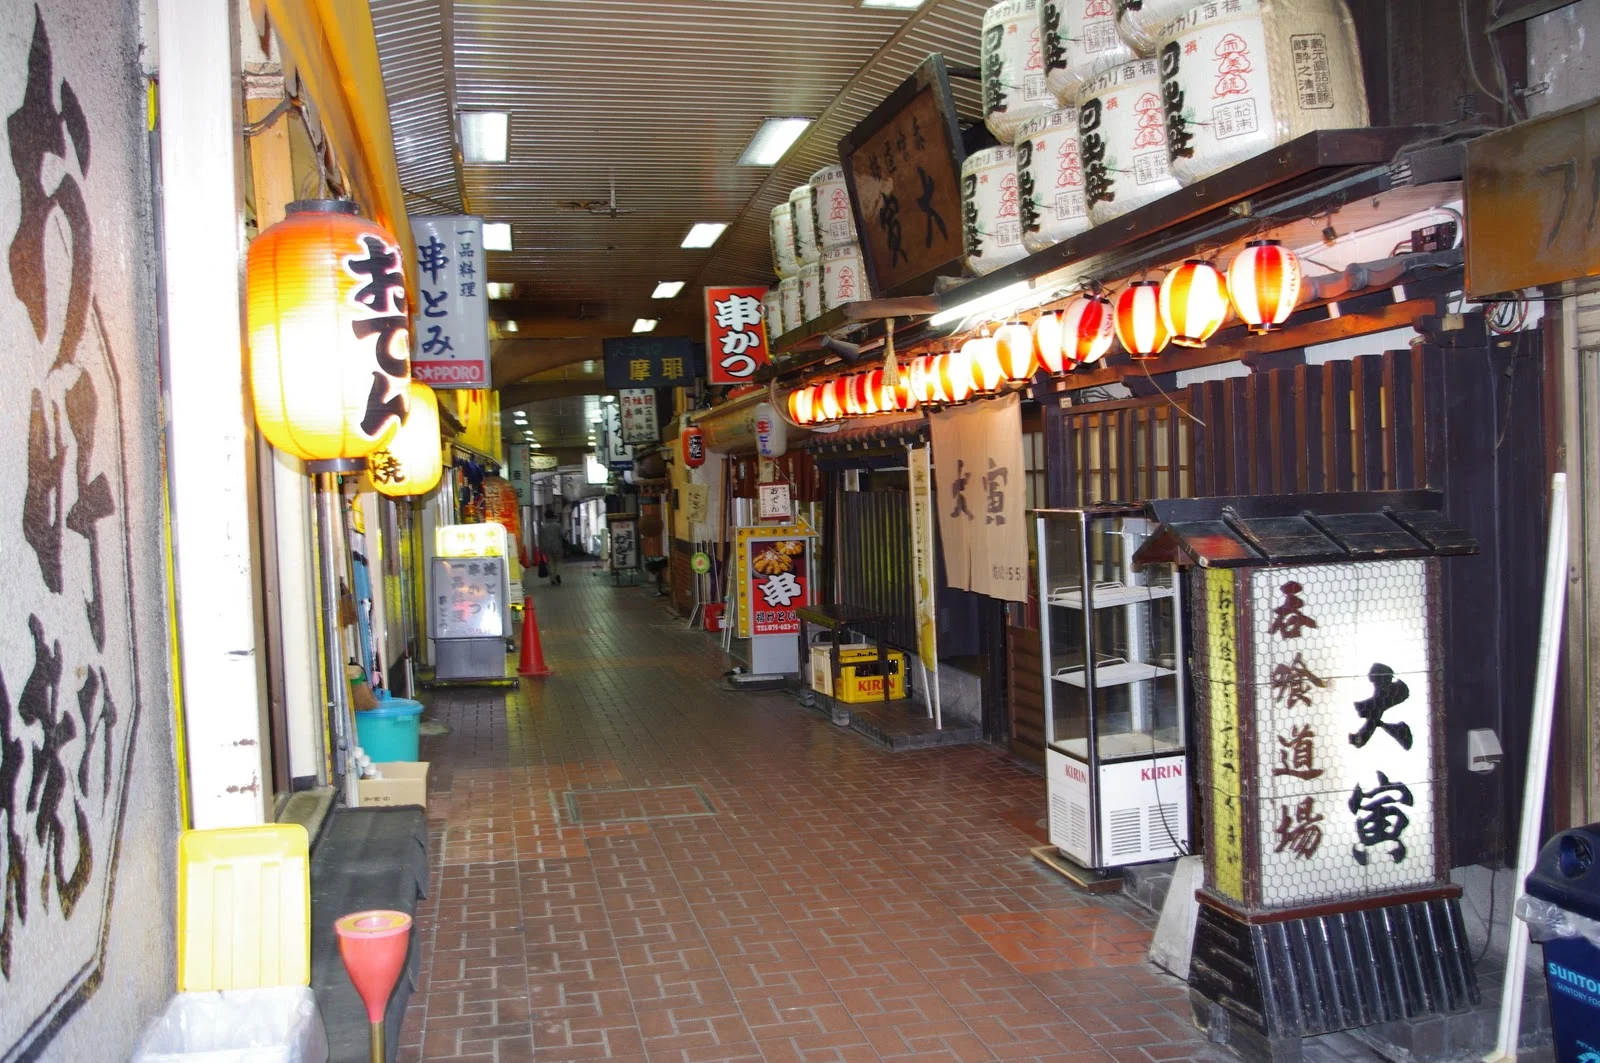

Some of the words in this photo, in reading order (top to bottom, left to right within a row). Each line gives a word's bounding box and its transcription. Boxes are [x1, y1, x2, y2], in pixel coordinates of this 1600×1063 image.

[456, 229, 477, 298] 一品料理
[347, 235, 411, 437] おでん
[713, 294, 762, 377] 串かつ
[757, 572, 802, 607] 串
[1064, 763, 1087, 785] KIRIN
[1140, 764, 1183, 782] KIRIN
[1348, 662, 1415, 866] 大寅
[1548, 962, 1600, 996] SUNTO
